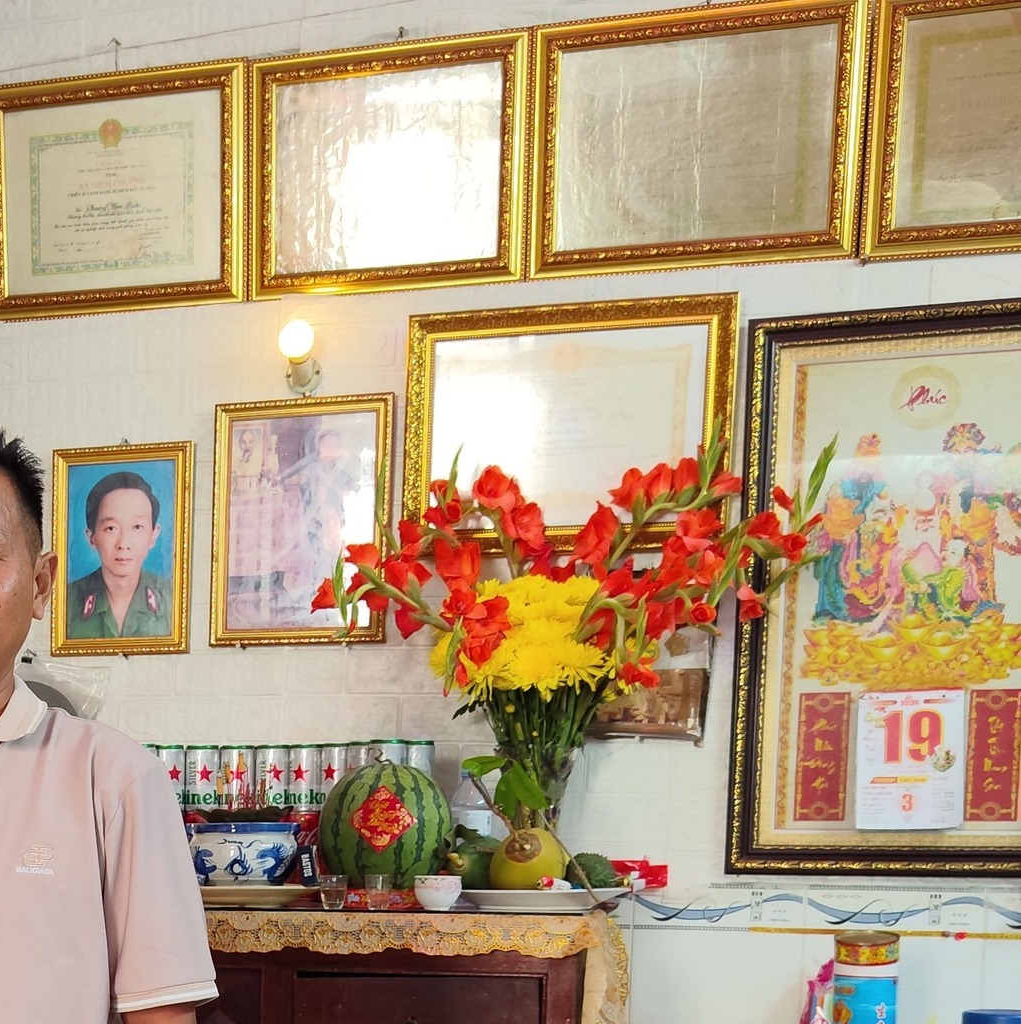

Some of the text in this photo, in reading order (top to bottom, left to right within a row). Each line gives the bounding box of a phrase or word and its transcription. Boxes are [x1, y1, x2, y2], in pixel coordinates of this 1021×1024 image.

[881, 708, 945, 764] 19
[902, 793, 913, 812] 3
[300, 853, 313, 878] BASTOS
